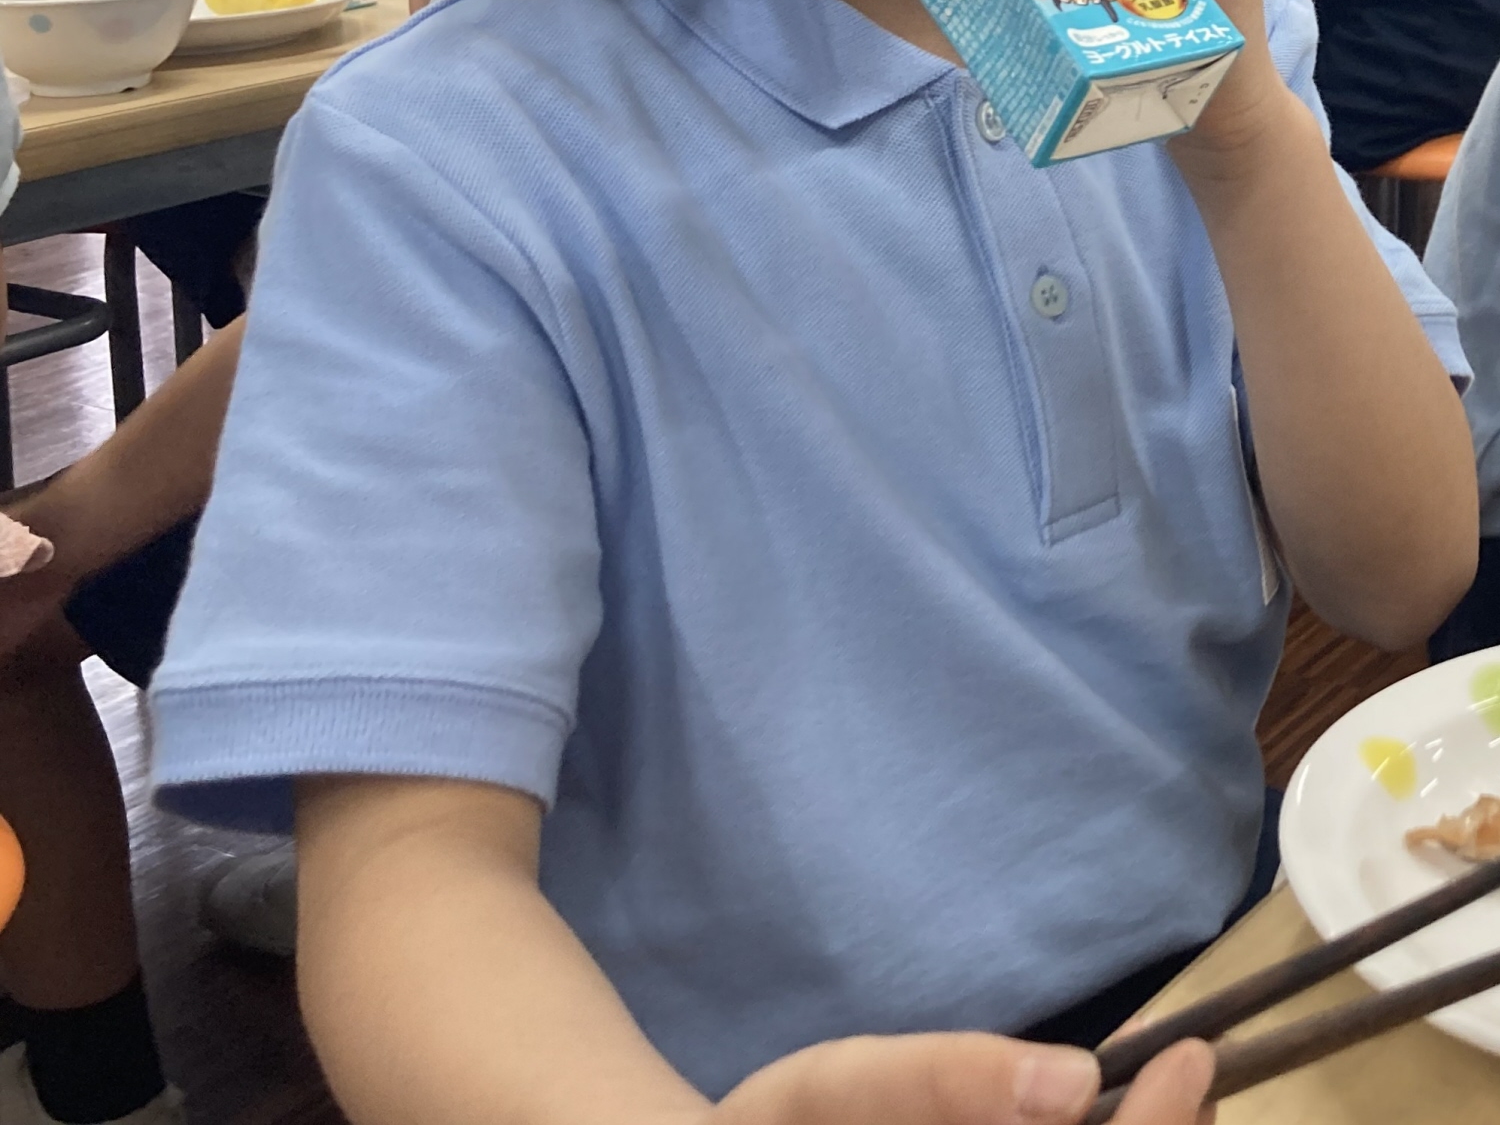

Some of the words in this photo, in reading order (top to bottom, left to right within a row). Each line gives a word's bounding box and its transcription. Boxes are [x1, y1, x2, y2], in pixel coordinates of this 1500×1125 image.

[1085, 24, 1232, 64] ヨーグルトテイスト
